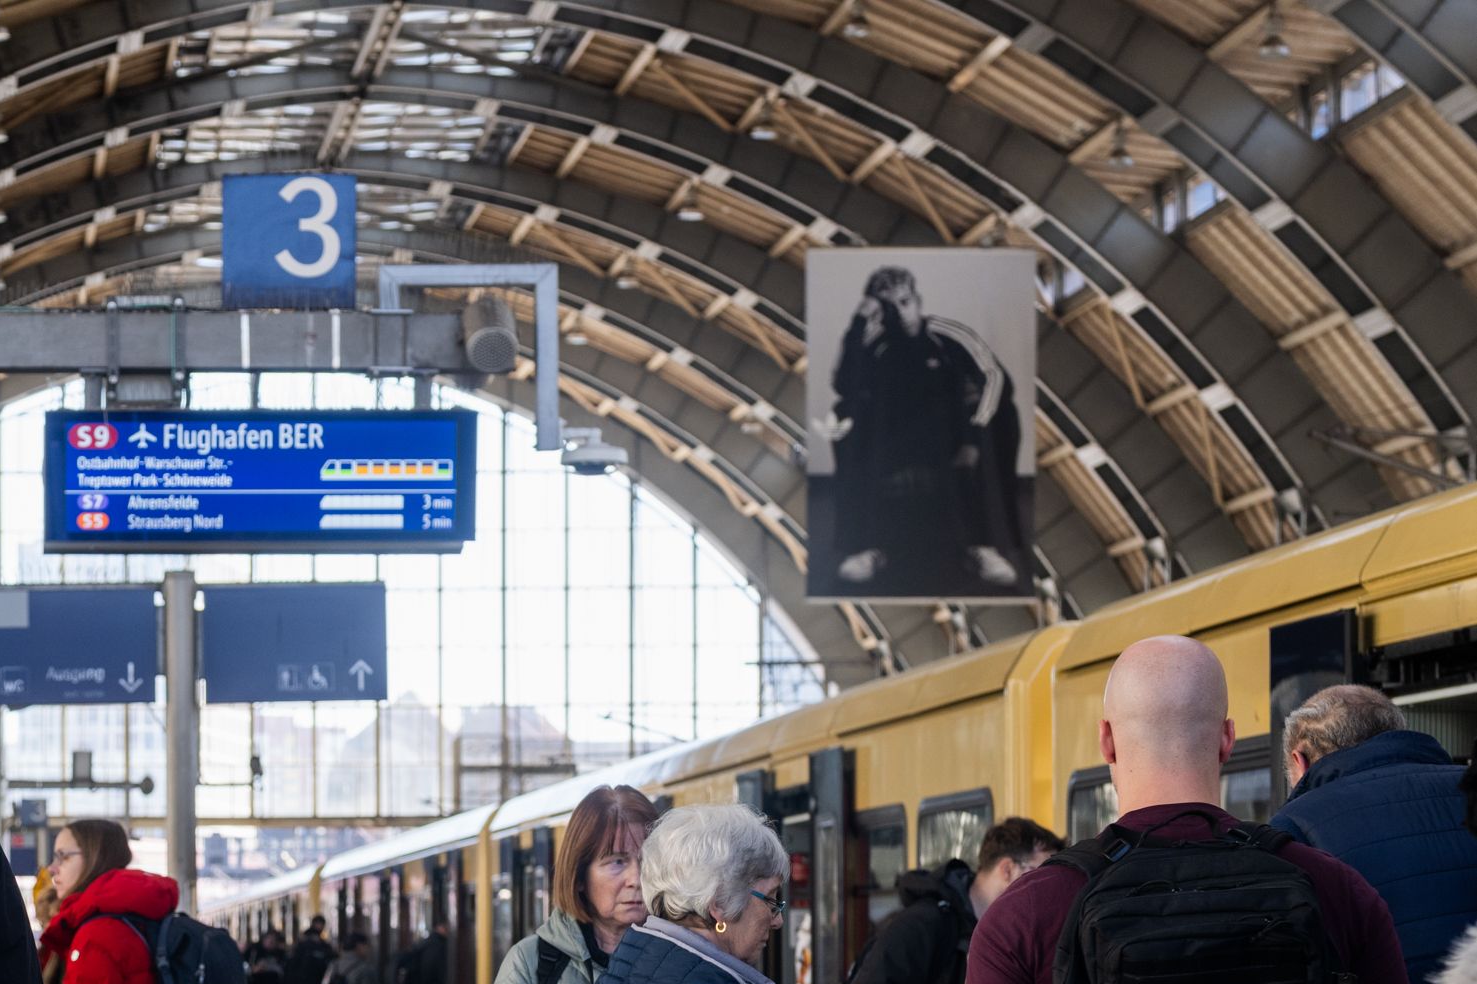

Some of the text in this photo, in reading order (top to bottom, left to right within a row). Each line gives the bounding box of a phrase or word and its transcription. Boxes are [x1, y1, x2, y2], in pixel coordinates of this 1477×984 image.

[275, 177, 342, 279] 3
[76, 425, 110, 448] S9
[163, 423, 324, 455] Flughafen BER
[77, 456, 139, 470] Ostbahnhof
[145, 456, 206, 470] Warschauer
[77, 472, 232, 489] Treptower Park Schöneweide
[82, 495, 104, 509] S7
[128, 494, 199, 510] Ahrensfelde
[422, 494, 452, 510] 3 min
[82, 514, 104, 529] S5
[128, 515, 223, 532] Strausberg Nord
[422, 514, 452, 529] 5 min
[46, 666, 106, 684] Ausgang
